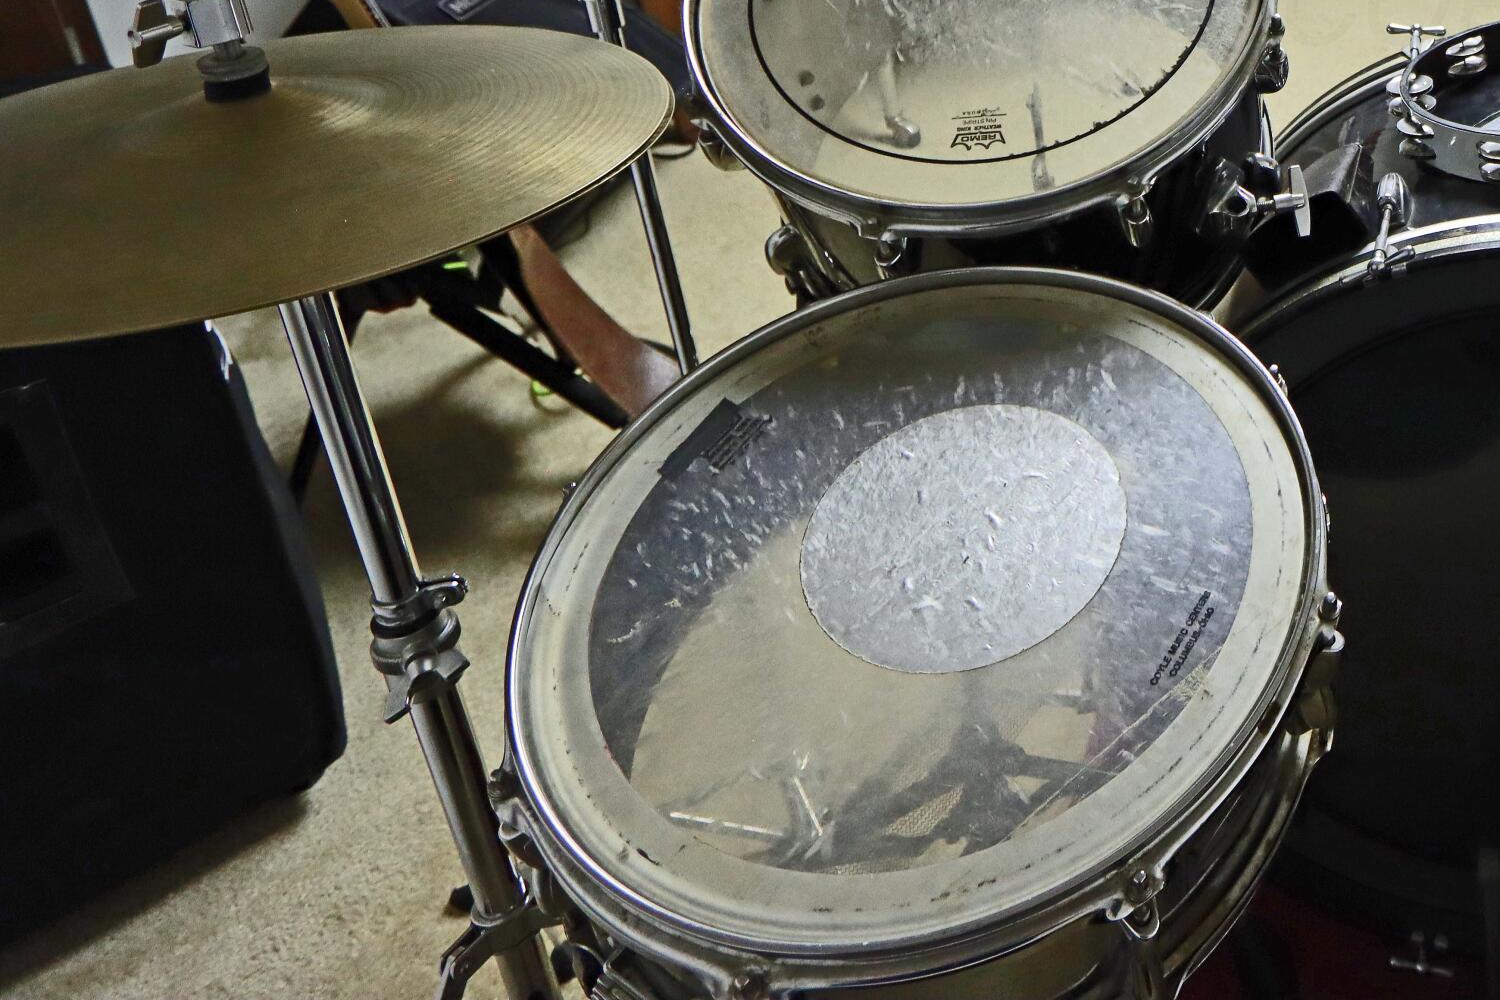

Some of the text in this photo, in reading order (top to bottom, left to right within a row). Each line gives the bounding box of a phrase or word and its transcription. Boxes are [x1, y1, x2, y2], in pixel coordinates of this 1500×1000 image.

[961, 134, 996, 142] REMO
[1198, 607, 1214, 628] OHIO
[1150, 656, 1173, 686] COYLE
[1168, 628, 1188, 655] MUSIC
